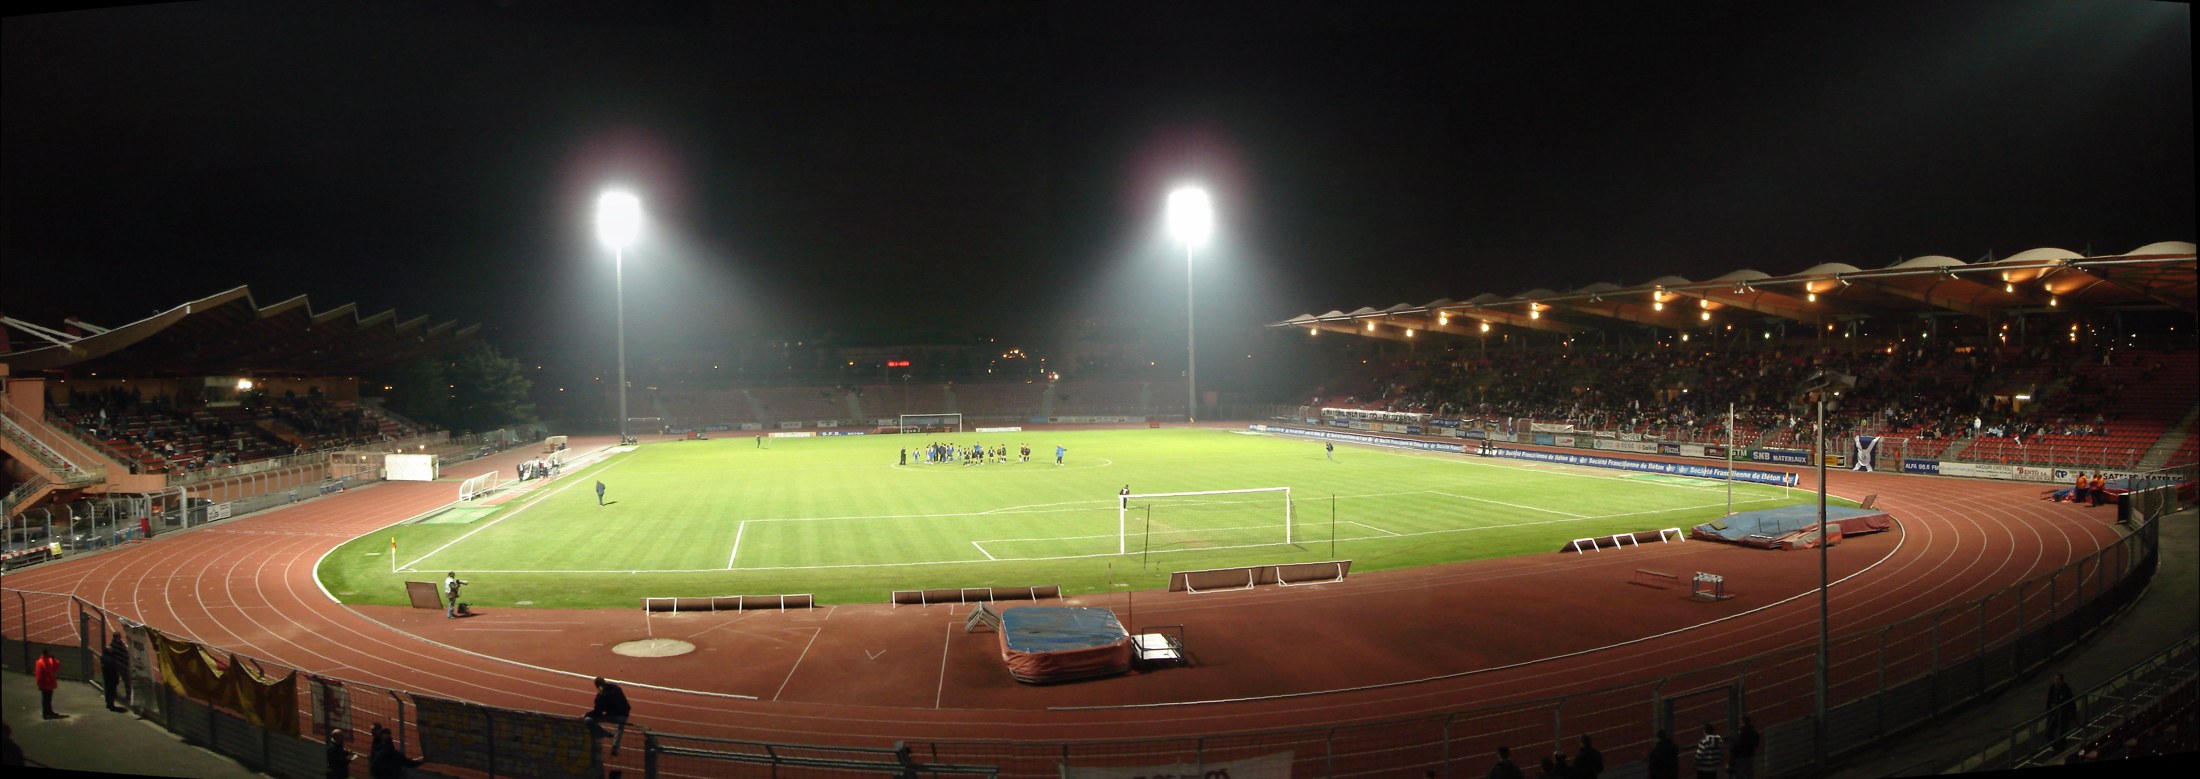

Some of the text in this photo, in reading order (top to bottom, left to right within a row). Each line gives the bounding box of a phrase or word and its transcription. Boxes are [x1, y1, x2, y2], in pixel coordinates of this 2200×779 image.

[1753, 452, 1770, 460] SNB
[1588, 457, 1607, 466] Société
[1689, 466, 1713, 475] Société
[1713, 469, 1751, 479] Franclienne
[1761, 473, 1781, 482] Béton
